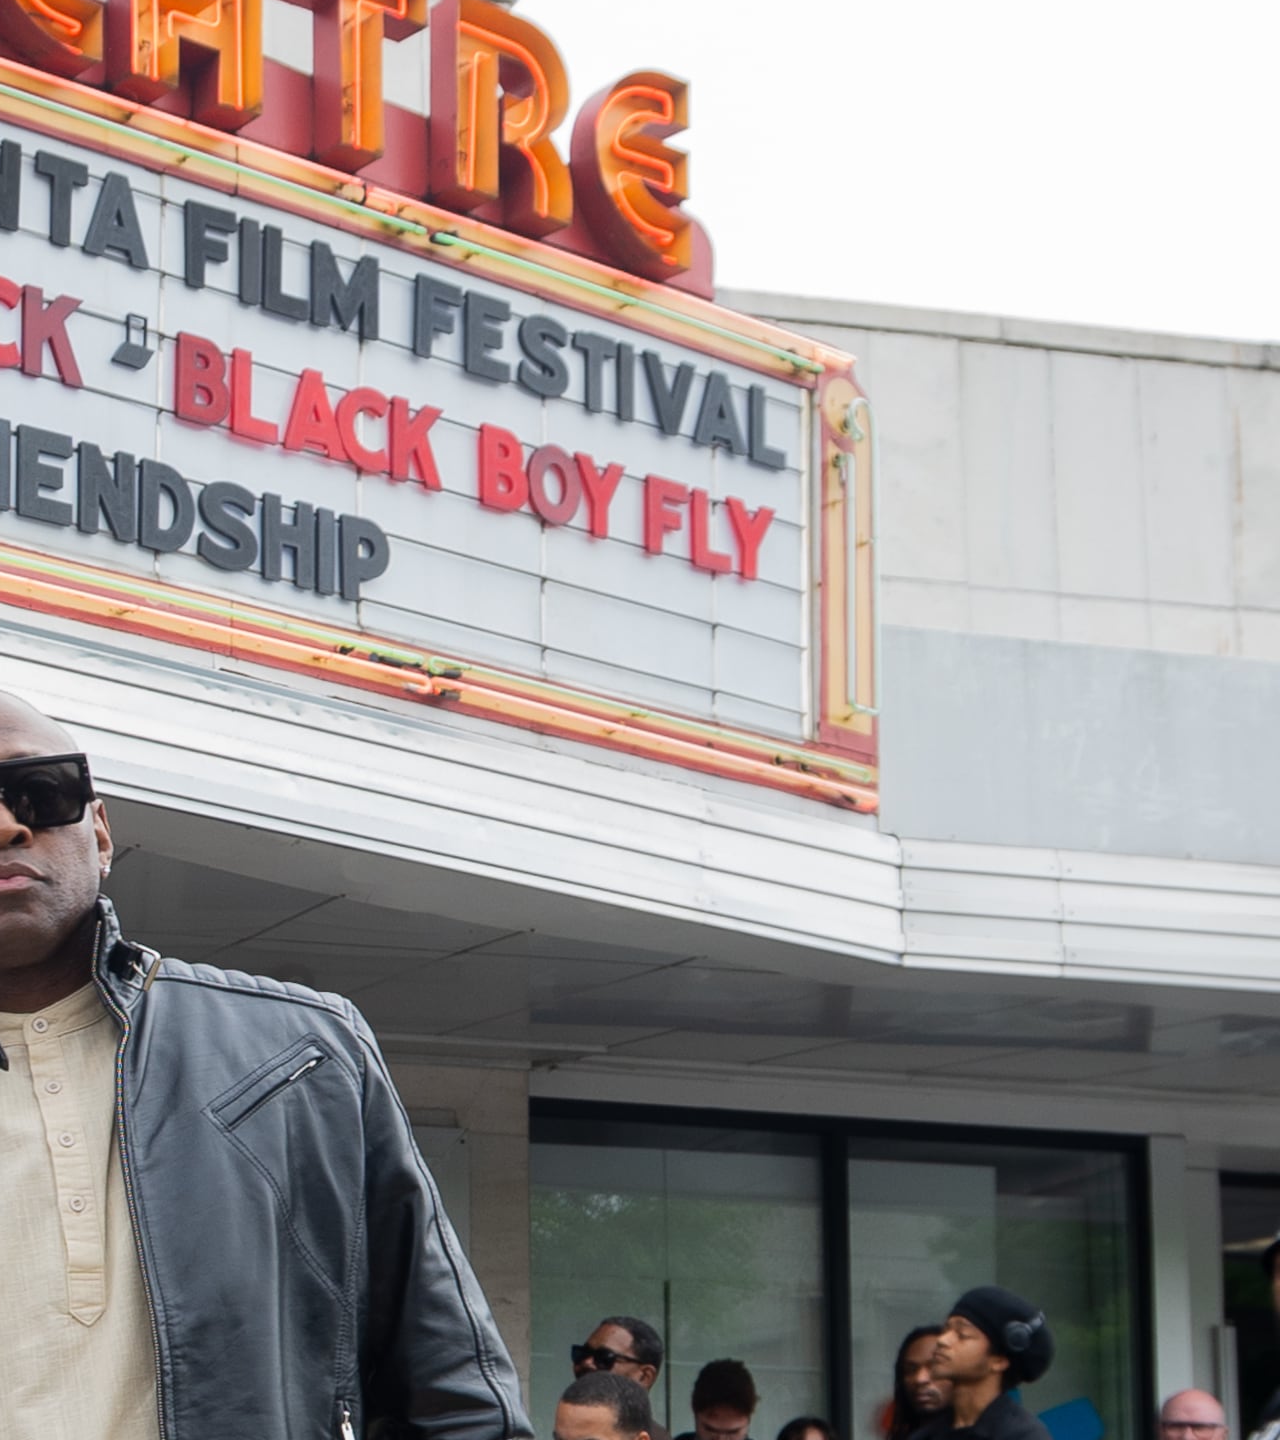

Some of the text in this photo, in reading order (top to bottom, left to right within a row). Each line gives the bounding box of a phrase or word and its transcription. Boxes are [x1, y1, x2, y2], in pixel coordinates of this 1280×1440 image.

[173, 330, 443, 491] BLACK
[476, 422, 626, 541] BOY
[643, 474, 776, 581] FLY
[182, 198, 380, 342] FILM
[412, 272, 787, 471] FESTIVAL
